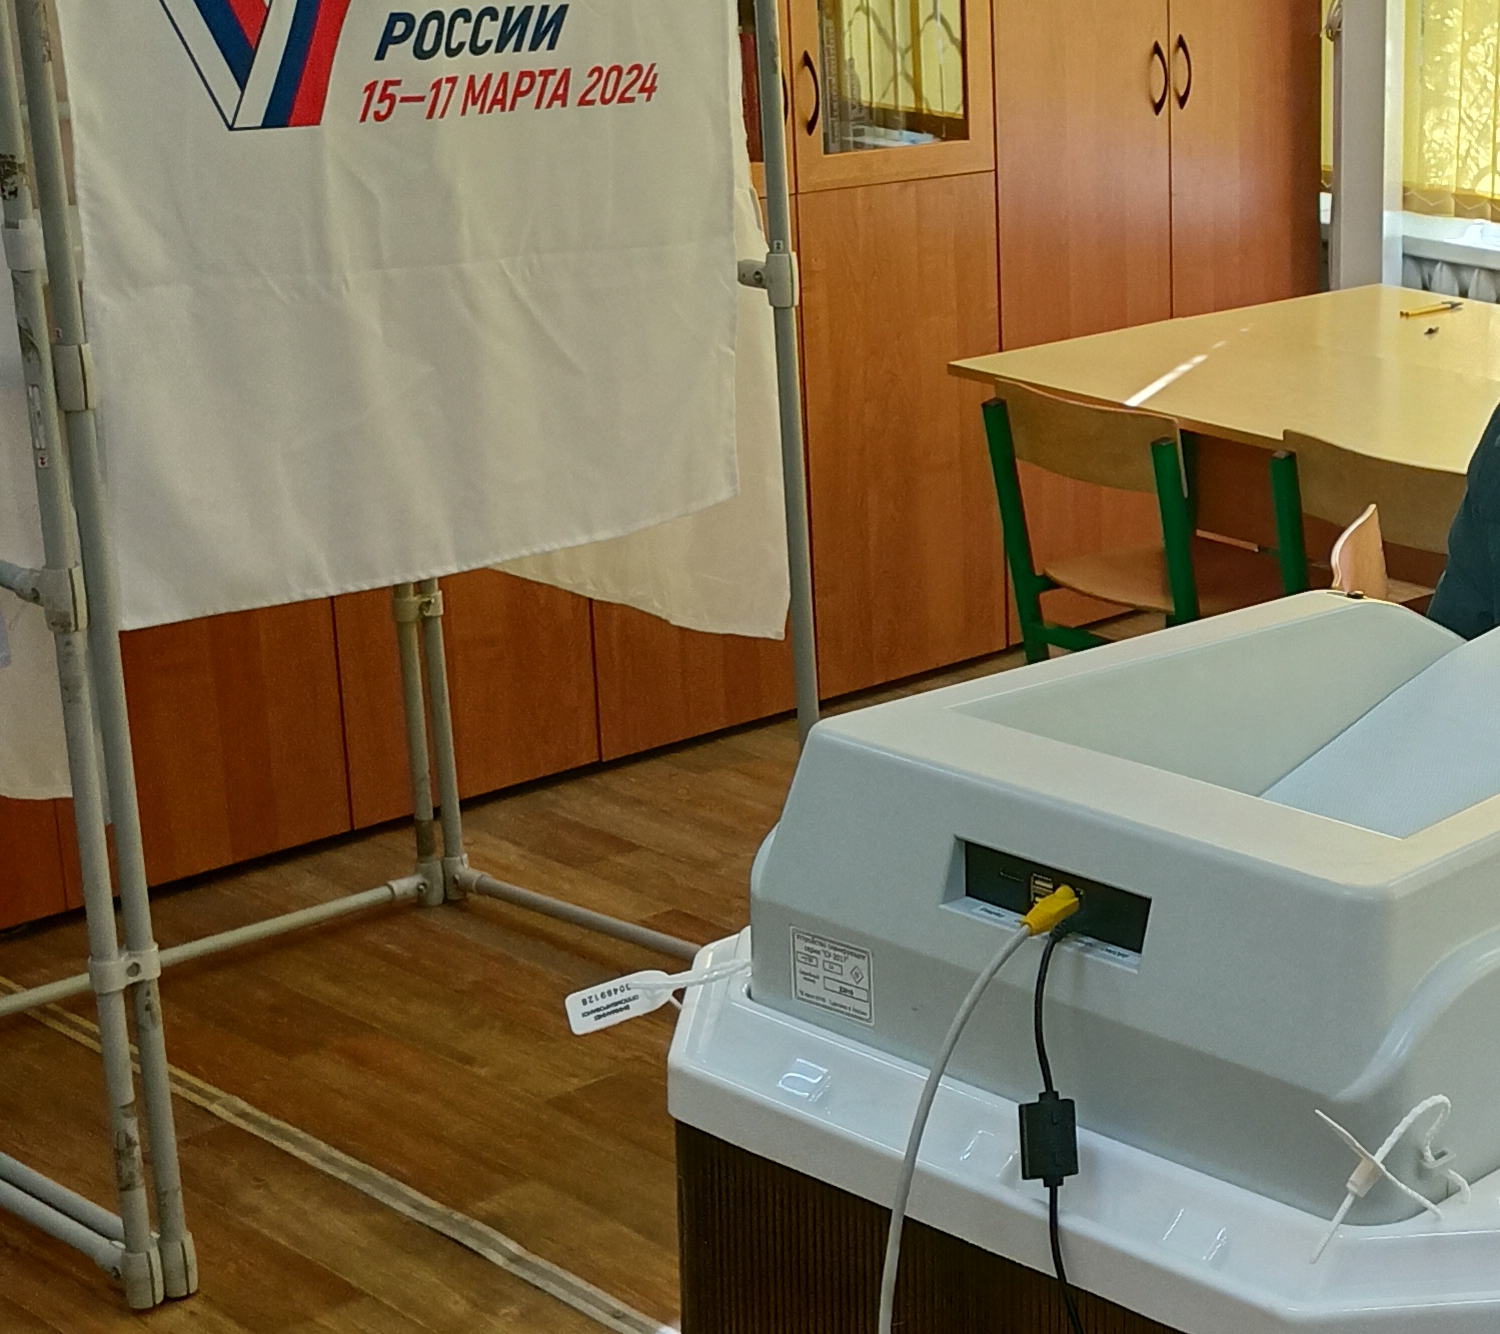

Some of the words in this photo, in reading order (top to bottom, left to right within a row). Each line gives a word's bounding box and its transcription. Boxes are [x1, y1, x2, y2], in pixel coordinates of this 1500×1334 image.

[374, 4, 570, 62] РОССИИ
[461, 67, 571, 117] МАРТА
[576, 62, 659, 108] 2024
